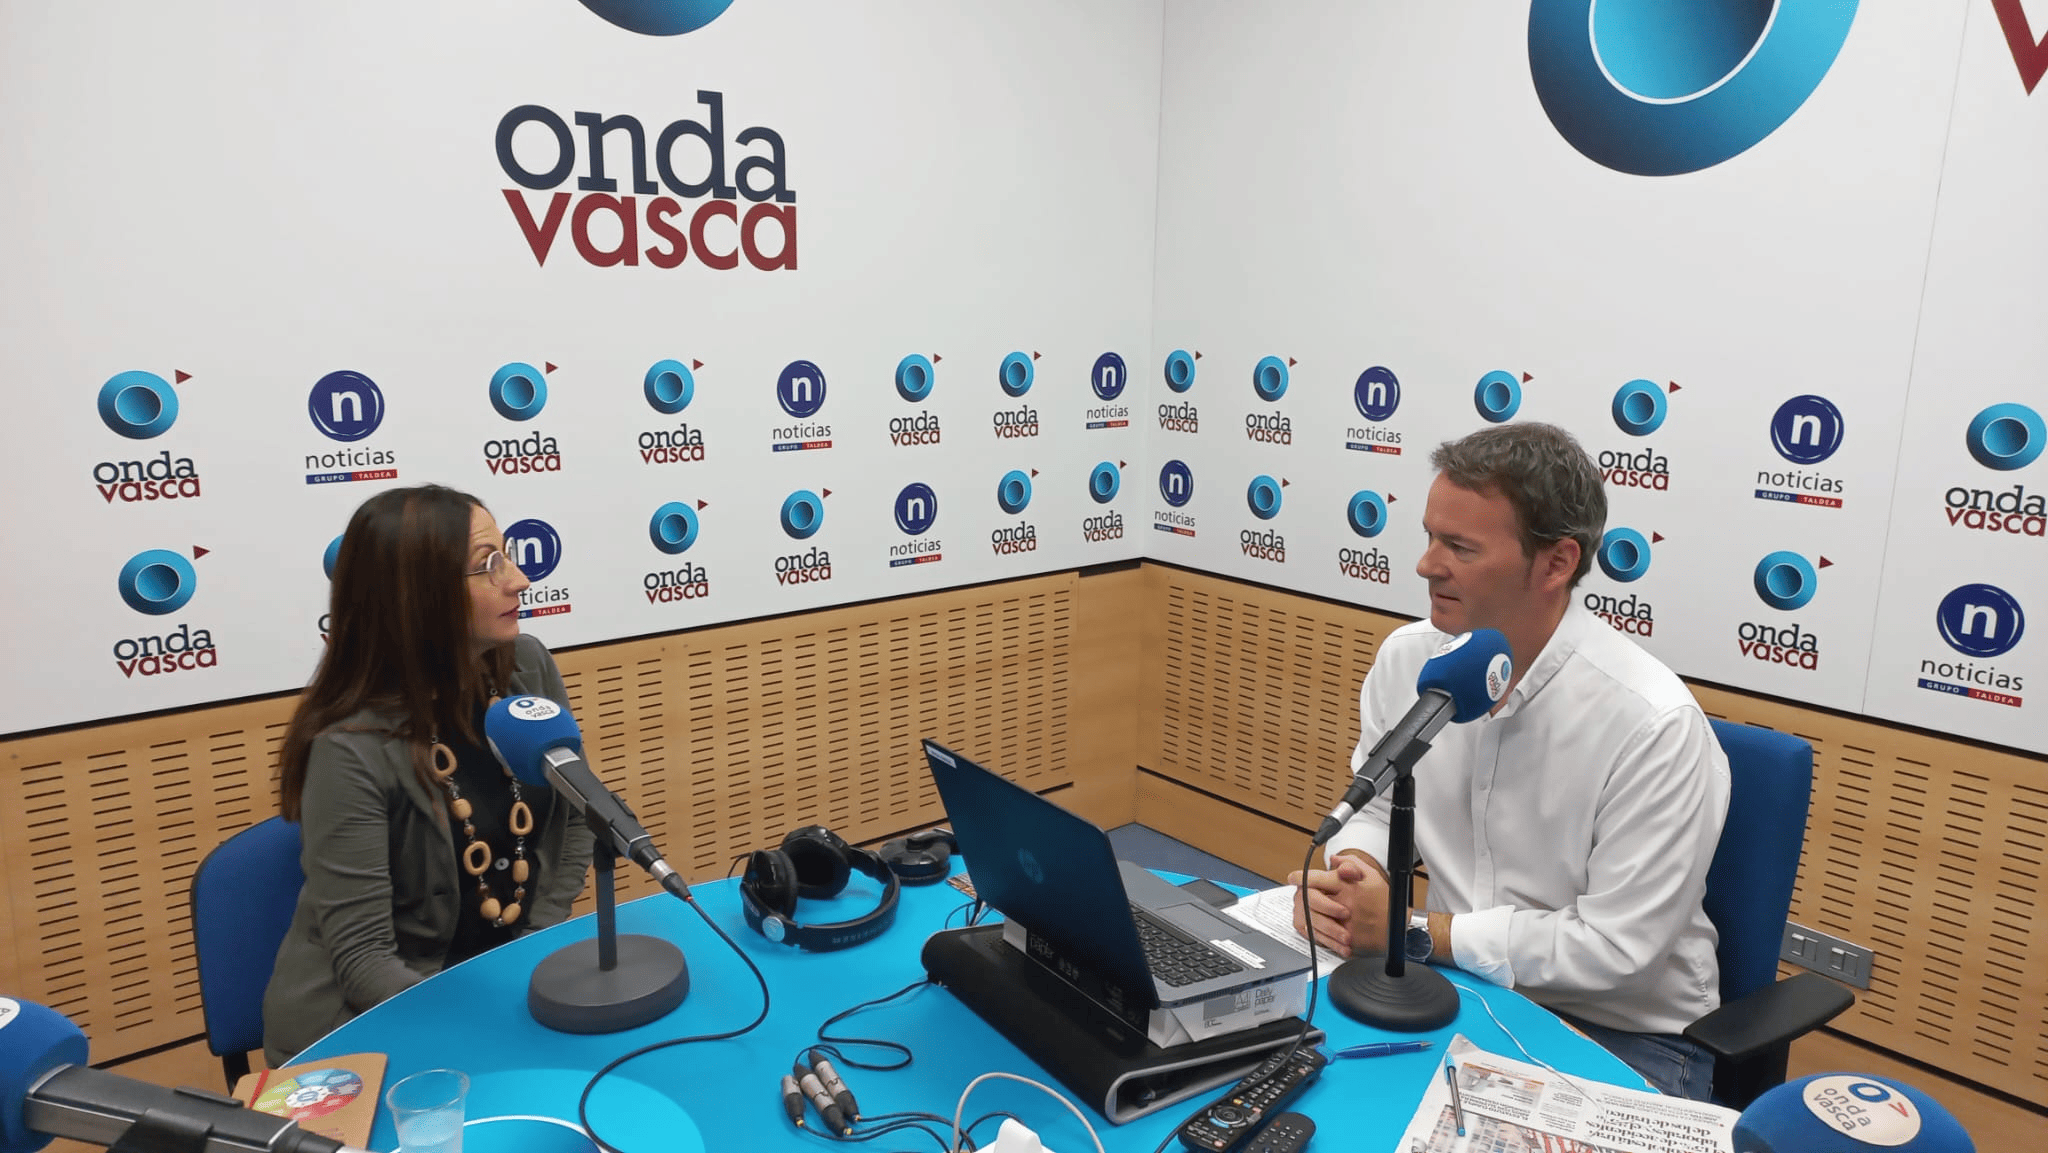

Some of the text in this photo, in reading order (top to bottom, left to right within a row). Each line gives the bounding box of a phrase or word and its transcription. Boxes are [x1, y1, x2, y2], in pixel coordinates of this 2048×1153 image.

[495, 90, 796, 203] onda
[502, 189, 797, 271] vasca
[889, 410, 938, 433] onda
[993, 405, 1038, 426] onda
[1086, 404, 1129, 419] noticias
[1158, 401, 1198, 422] onda
[1246, 411, 1291, 433] onda
[638, 423, 704, 449] onda
[772, 422, 832, 440] noticias
[994, 423, 1038, 439] vasca
[1158, 417, 1198, 434] vasca
[1346, 426, 1401, 444] noticias
[484, 431, 560, 459] onda
[890, 429, 940, 447] vasca
[1247, 429, 1291, 446] vasca
[305, 447, 395, 469] noticias
[485, 453, 561, 475] vasca
[640, 444, 704, 465] vasca
[1598, 448, 1669, 474] onda
[93, 451, 198, 484] onda
[97, 476, 200, 504] vasca
[1757, 470, 1843, 493] noticias
[1945, 485, 2047, 521] onda
[1083, 510, 1123, 531] onda
[1154, 510, 1195, 527] noticias
[1945, 507, 2046, 538] vasca
[992, 521, 1036, 543] onda
[1084, 528, 1123, 542] vasca
[1241, 529, 1285, 549] onda
[889, 538, 941, 556] noticias
[992, 538, 1036, 555] vasca
[1242, 544, 1285, 564] vasca
[775, 547, 831, 572] onda
[1339, 548, 1390, 571] onda
[644, 562, 708, 592] onda
[776, 565, 831, 585] vasca
[1339, 562, 1390, 585] vasca
[520, 586, 570, 605] ticias
[645, 582, 708, 605] vasca
[1584, 593, 1654, 622] onda
[1594, 611, 1653, 637] asca
[114, 624, 214, 660] onda
[1738, 622, 1819, 653] onda
[117, 648, 217, 679] vasca
[1738, 639, 1818, 671] vasca
[1921, 659, 2023, 691] noticias
[1813, 1093, 1857, 1131] vasca
[1823, 1088, 1872, 1127] onda
